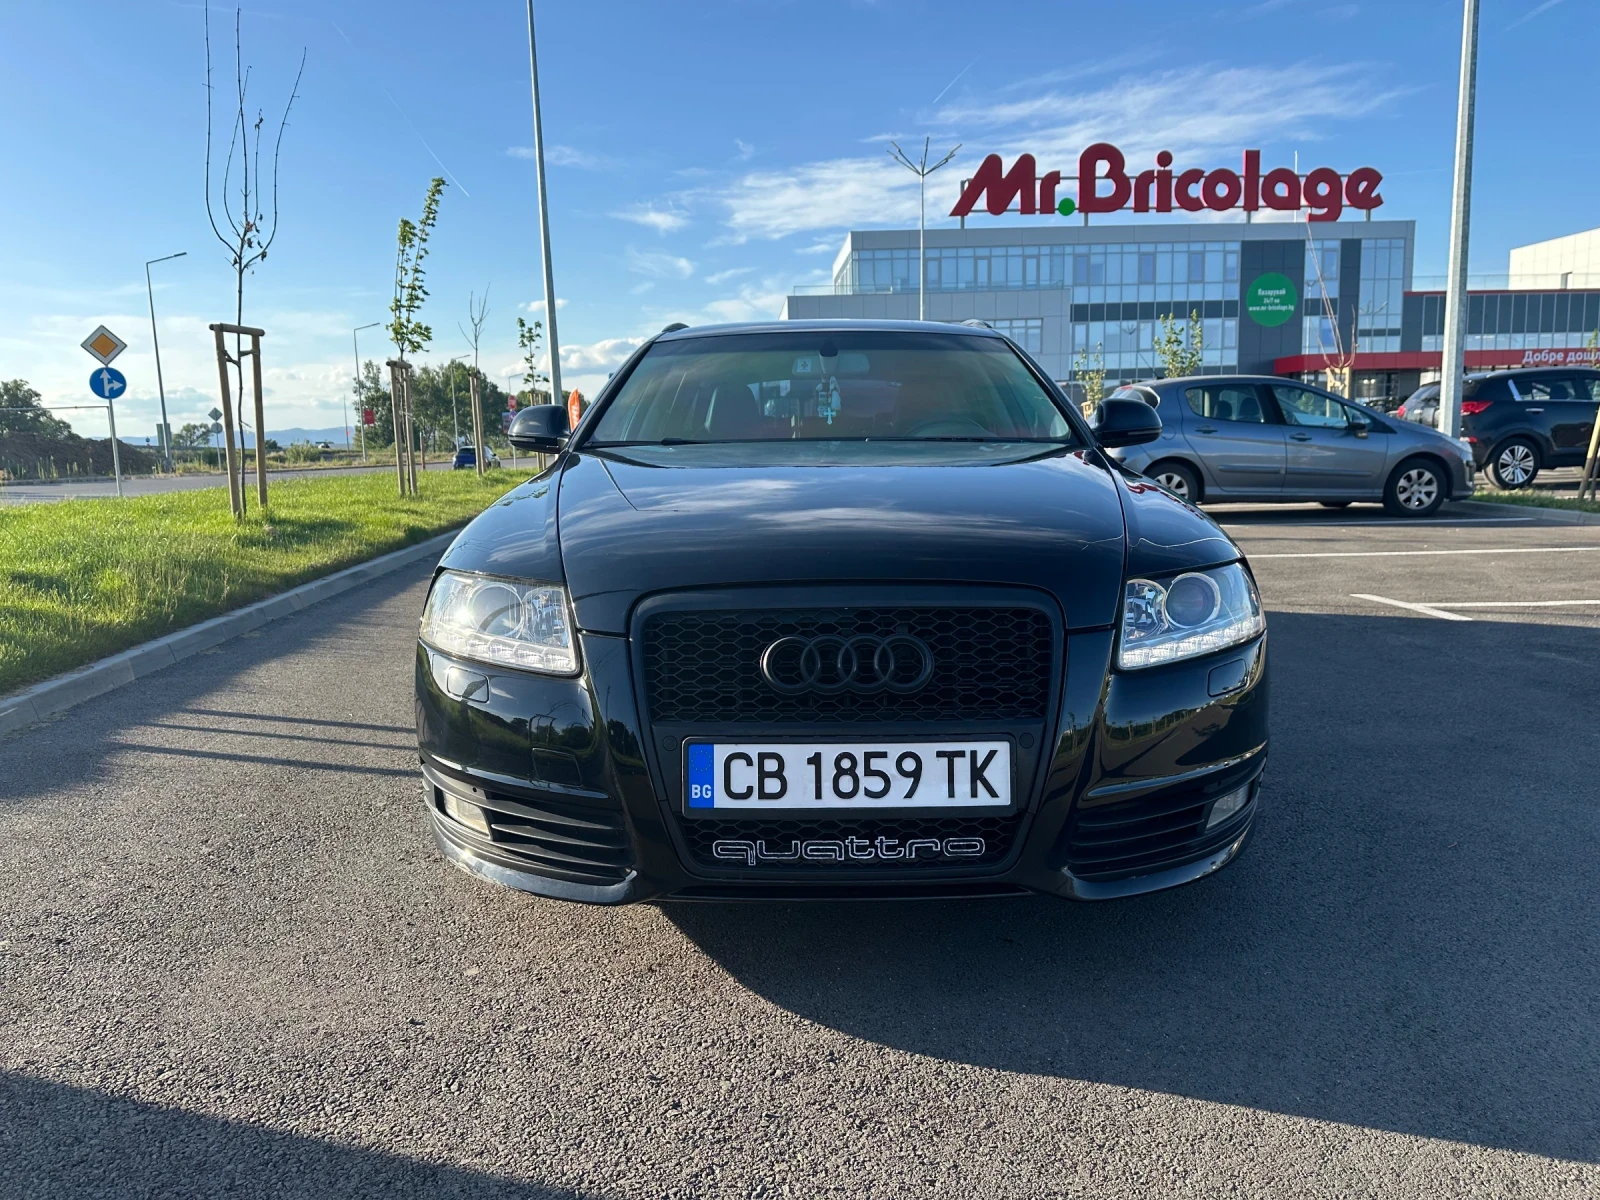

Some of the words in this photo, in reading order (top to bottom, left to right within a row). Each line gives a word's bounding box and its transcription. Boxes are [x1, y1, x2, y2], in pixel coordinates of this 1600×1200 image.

[1522, 349, 1564, 364] Добре
[723, 751, 788, 800] CB
[806, 750, 923, 800] 1859
[935, 749, 1000, 799] TK
[691, 784, 712, 799] BG
[712, 836, 986, 866] quattro
